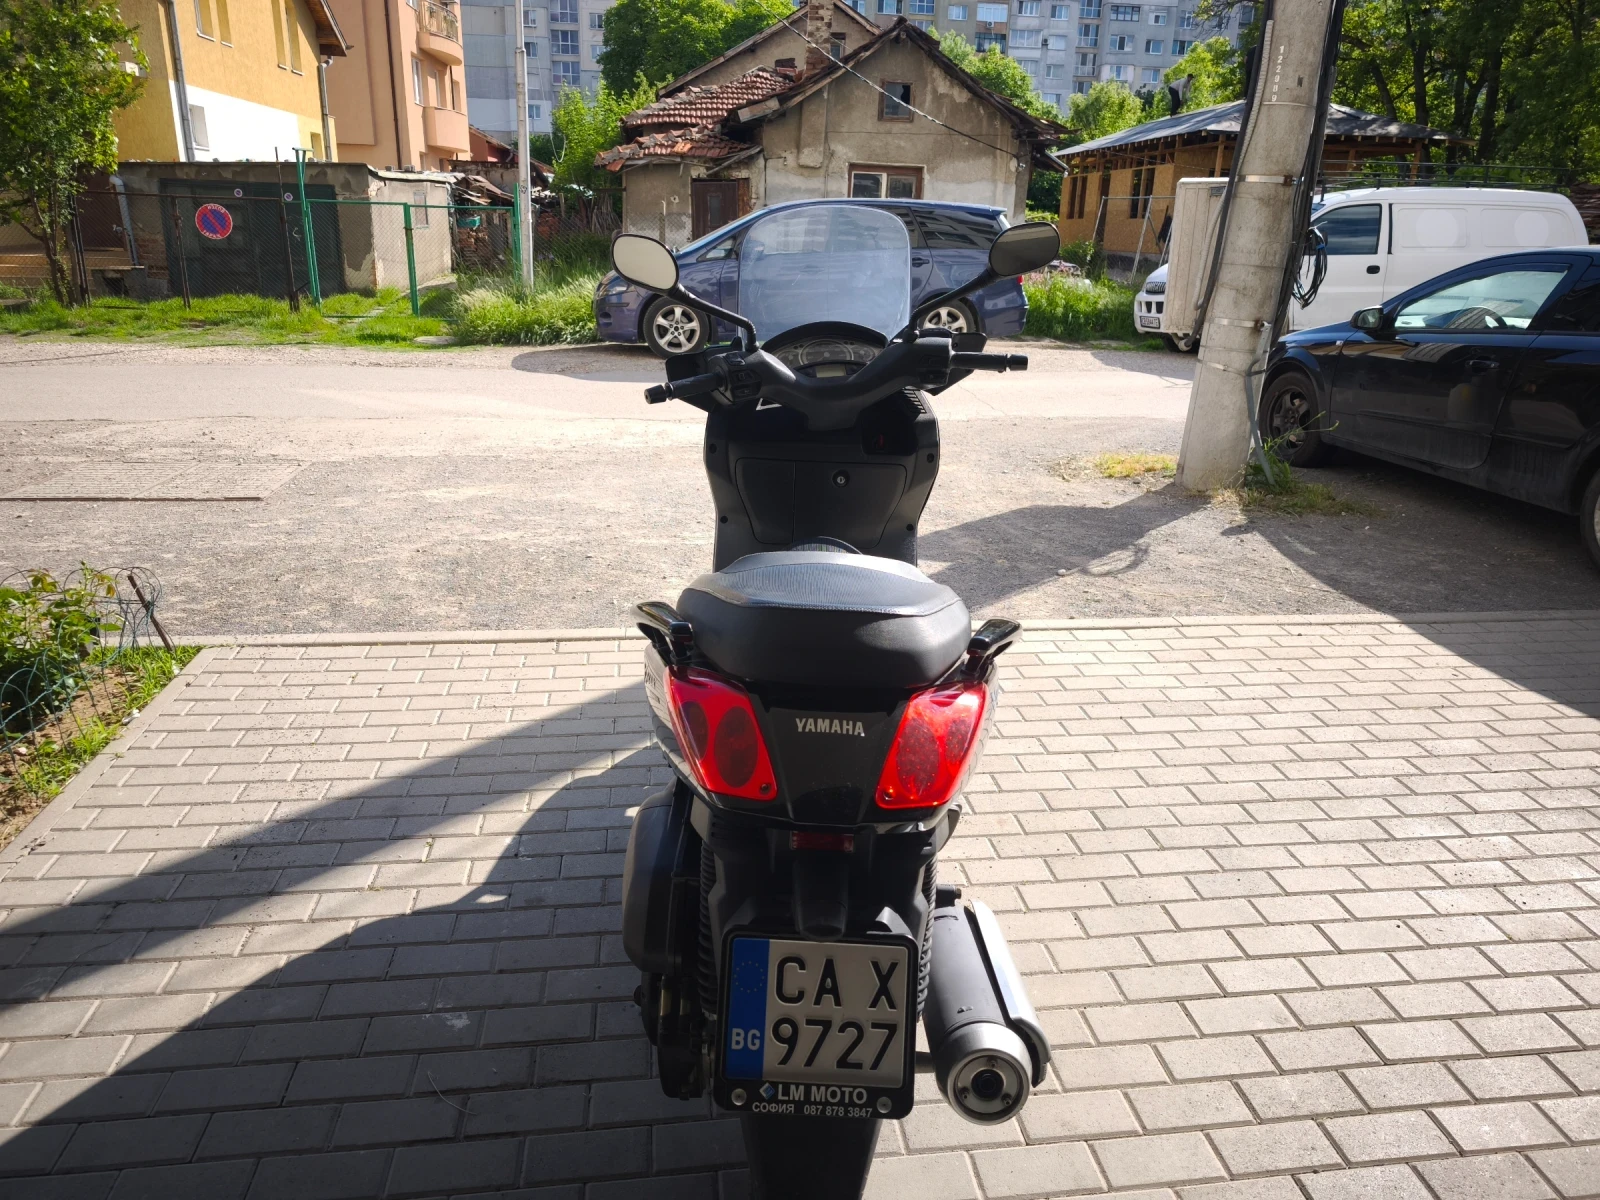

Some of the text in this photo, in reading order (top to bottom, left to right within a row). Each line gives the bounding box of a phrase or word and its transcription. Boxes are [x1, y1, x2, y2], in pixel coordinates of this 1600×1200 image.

[795, 717, 866, 737] YAMAHA
[775, 955, 899, 1012] CA X
[731, 1027, 761, 1051] BG
[771, 1016, 898, 1071] 9727
[777, 1083, 868, 1105] LM MOTO
[751, 1101, 873, 1118] СОФИЯ 087 878 3847
